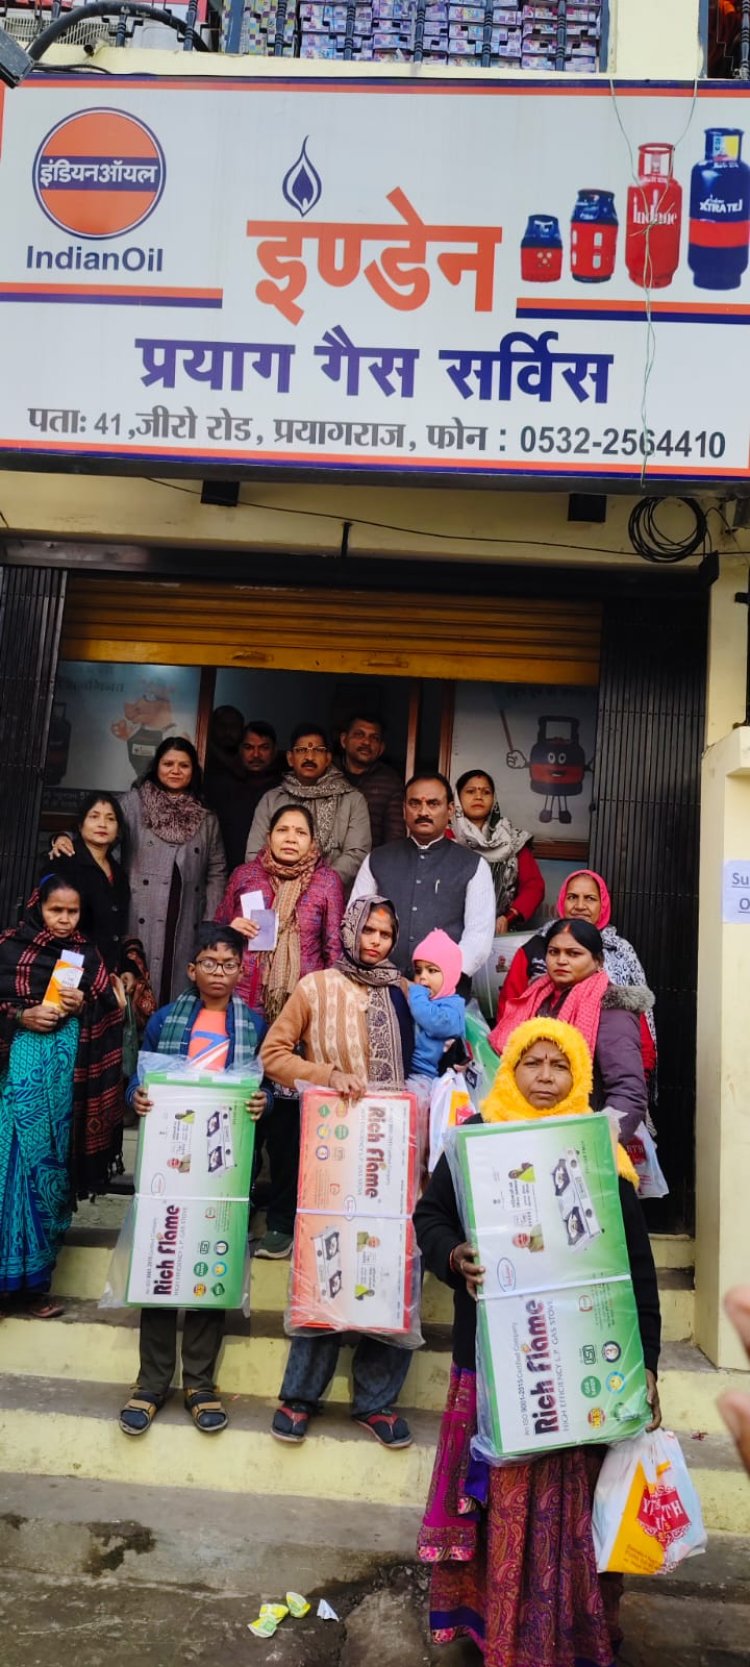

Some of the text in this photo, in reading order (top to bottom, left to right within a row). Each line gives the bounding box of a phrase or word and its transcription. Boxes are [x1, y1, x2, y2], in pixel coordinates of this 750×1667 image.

[40, 159, 158, 187] इंडियनऑयल
[26, 246, 164, 272] IndianOil
[247, 186, 502, 326] इण्डेन
[135, 324, 614, 404] प्रयाग गैस सर्विस
[520, 426, 726, 459] 0532-2564410
[365, 1106, 386, 1198] Rich Flame
[153, 1204, 181, 1295] Rich Flame
[524, 1299, 560, 1435] Rich Flame
